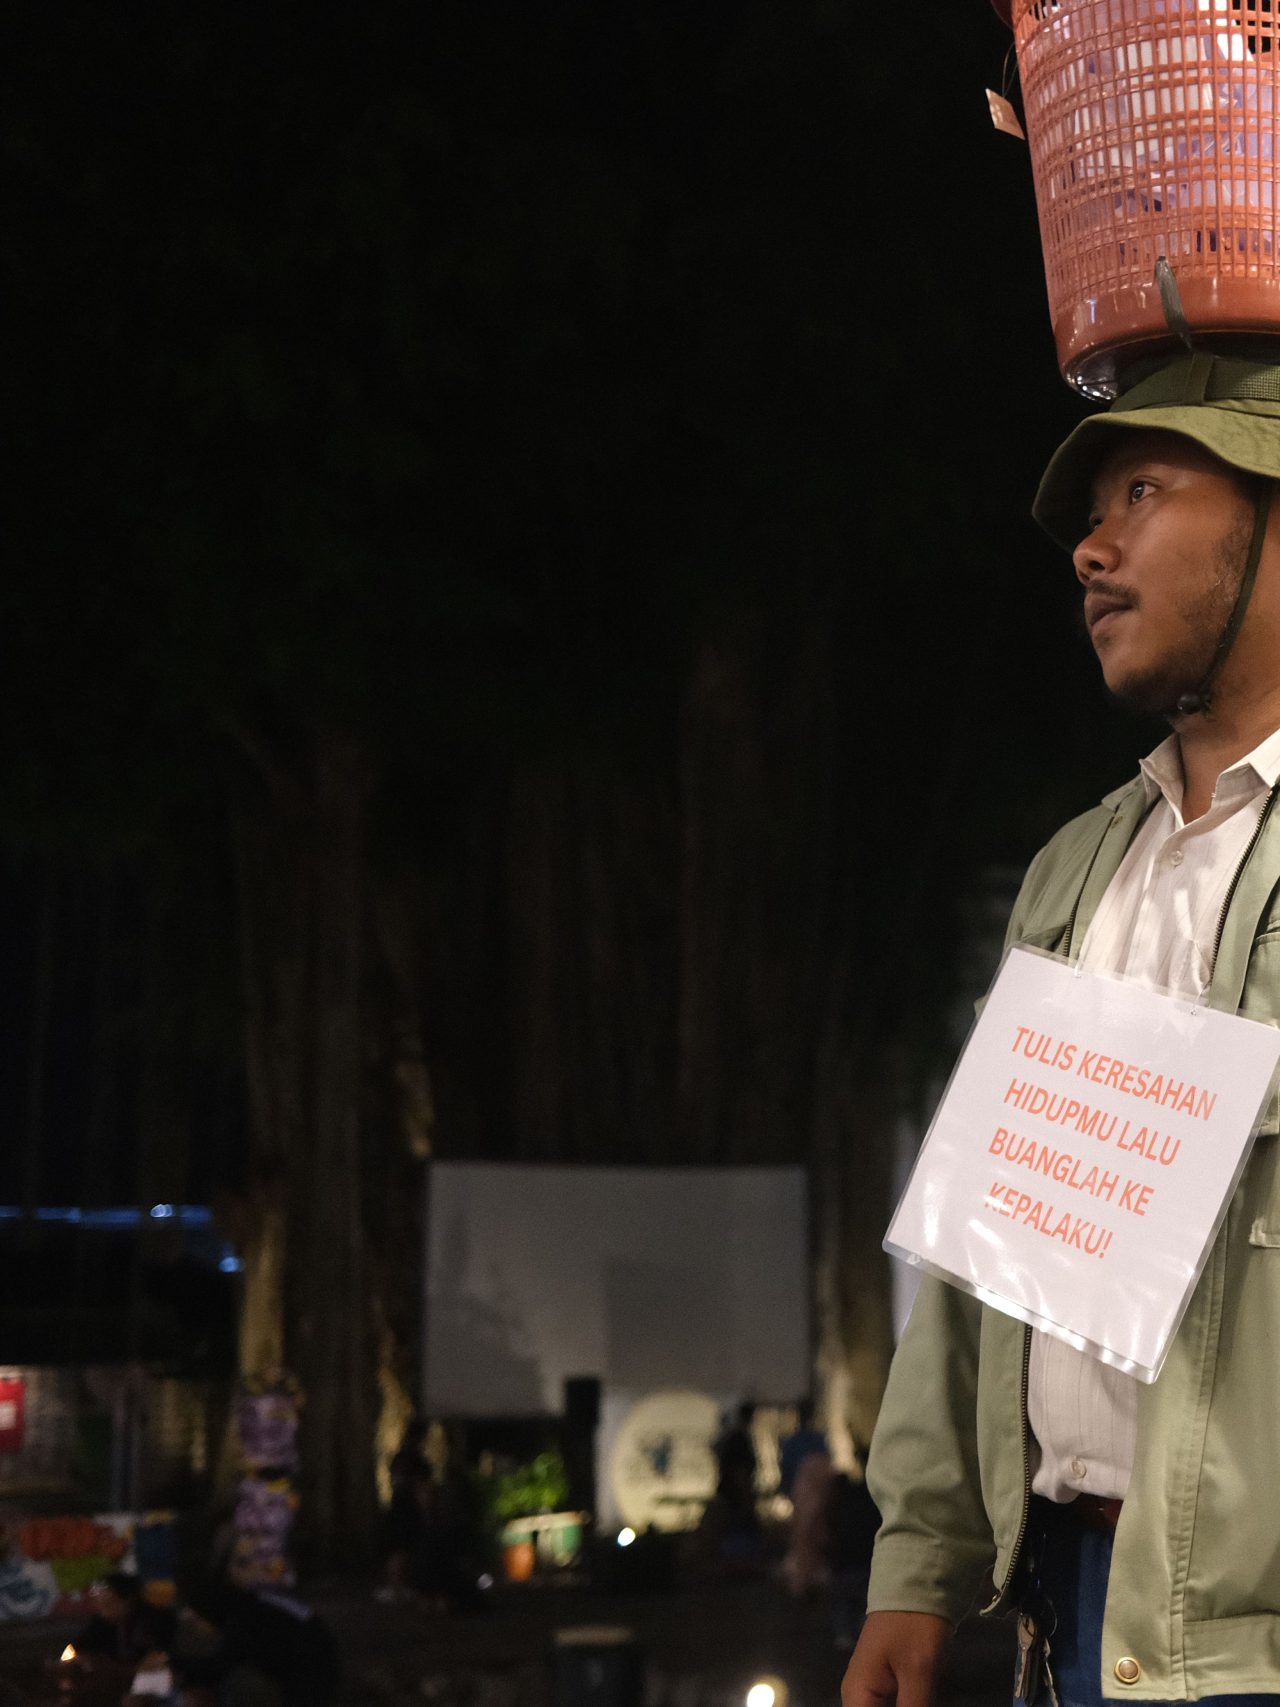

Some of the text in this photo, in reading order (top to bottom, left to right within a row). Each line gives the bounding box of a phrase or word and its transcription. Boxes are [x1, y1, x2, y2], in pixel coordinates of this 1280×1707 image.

[1011, 1026, 1217, 1121] TULIS KERESAHAN
[1003, 1078, 1181, 1166] HIDUPMU LALU
[988, 1127, 1154, 1216] BUANGLAH KE
